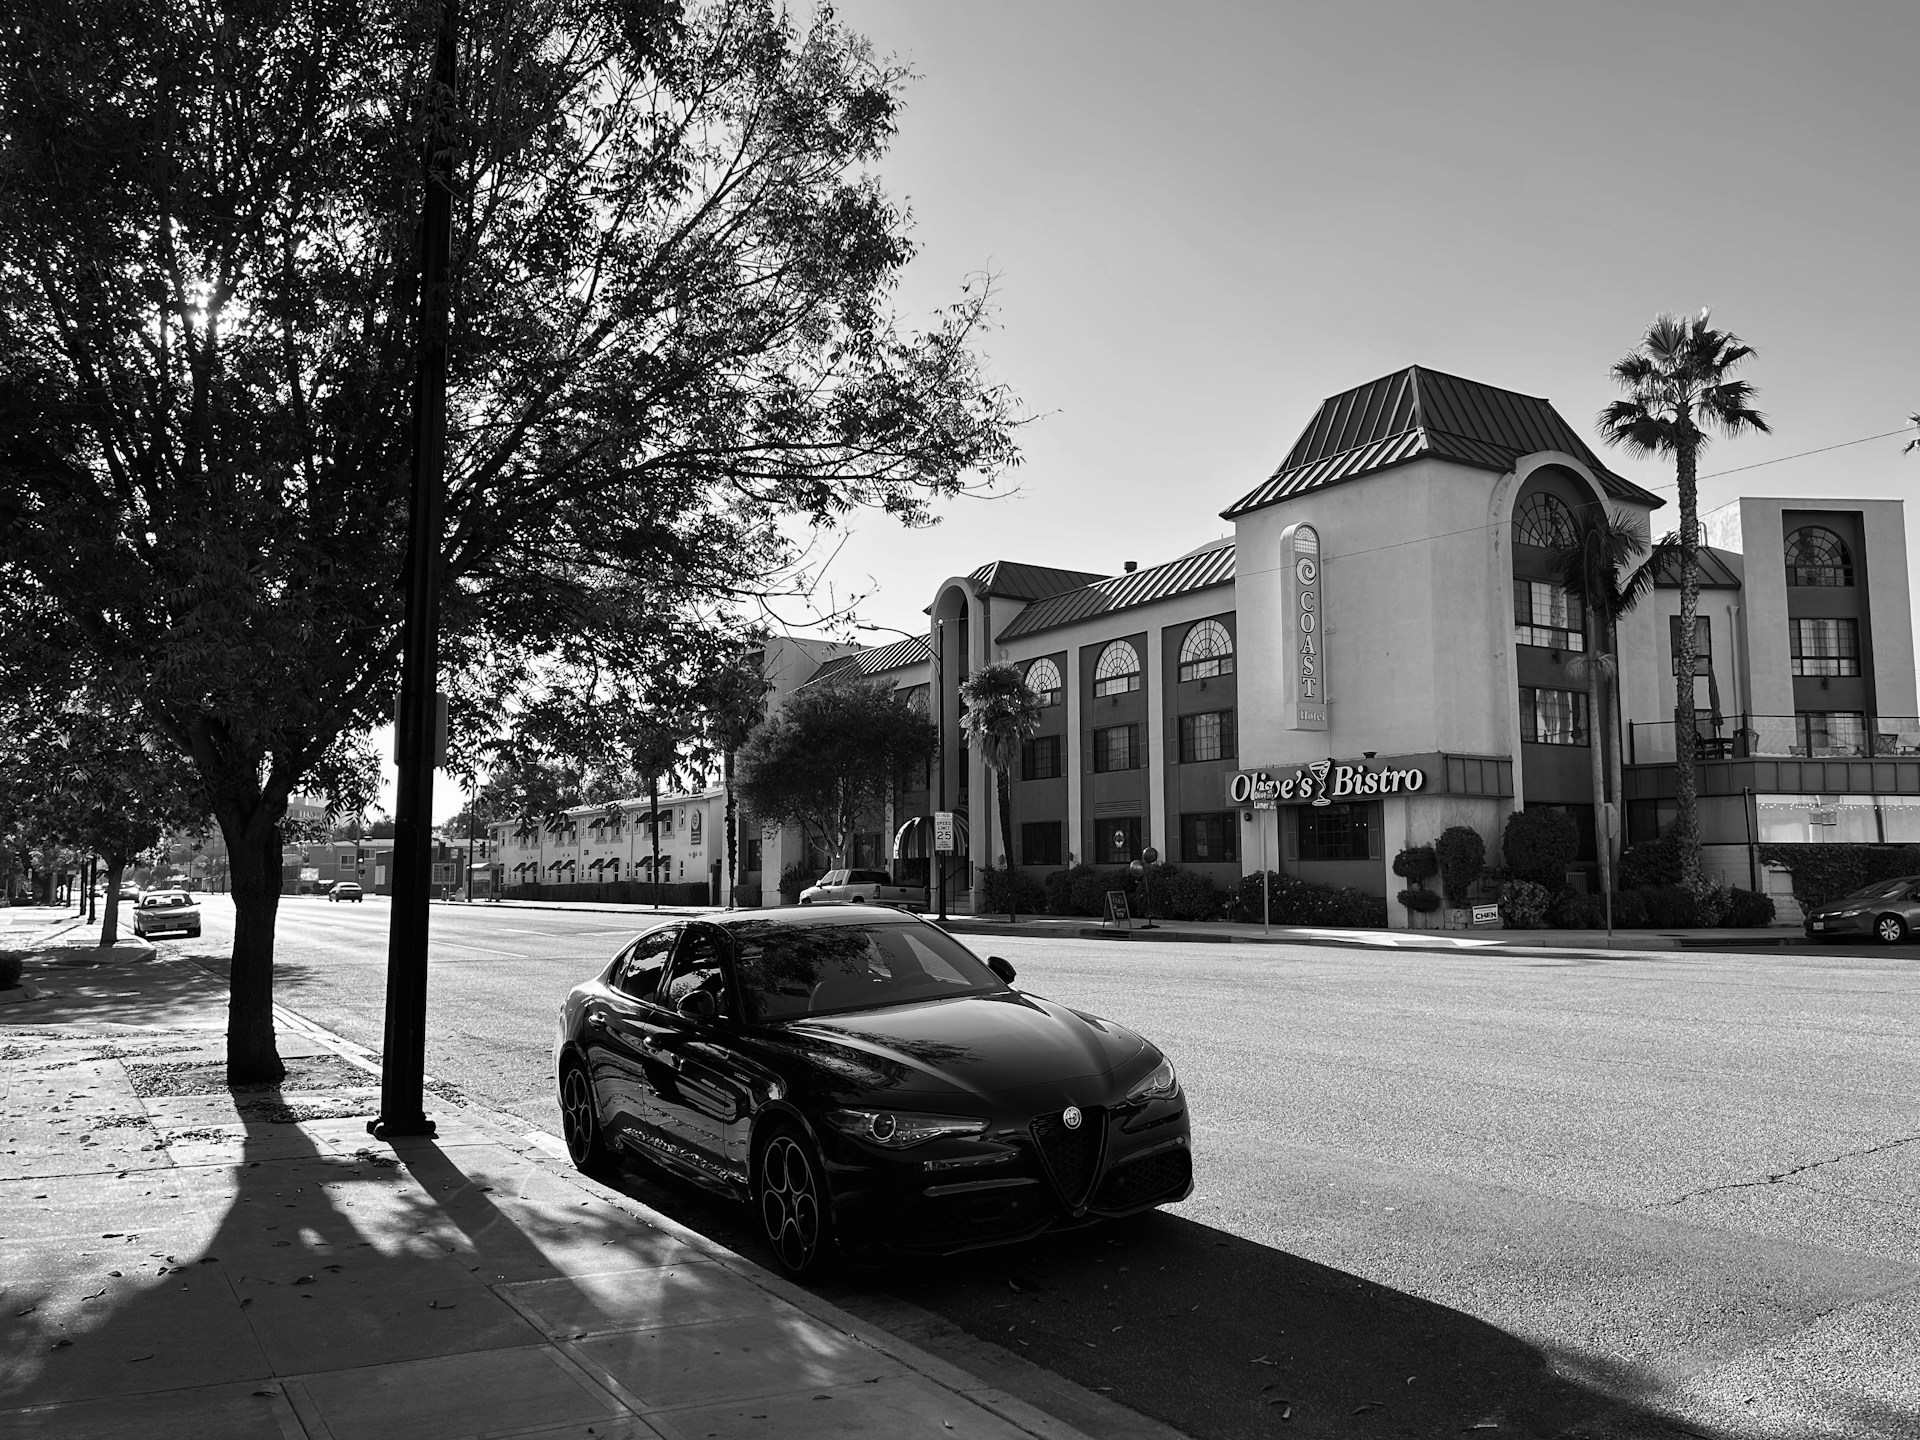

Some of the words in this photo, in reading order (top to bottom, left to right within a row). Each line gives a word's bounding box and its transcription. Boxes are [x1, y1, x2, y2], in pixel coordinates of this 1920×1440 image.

[1300, 591, 1317, 698] COAST
[1300, 710, 1325, 721] Hotel
[1332, 765, 1423, 796] Bistro
[937, 831, 951, 840] 25
